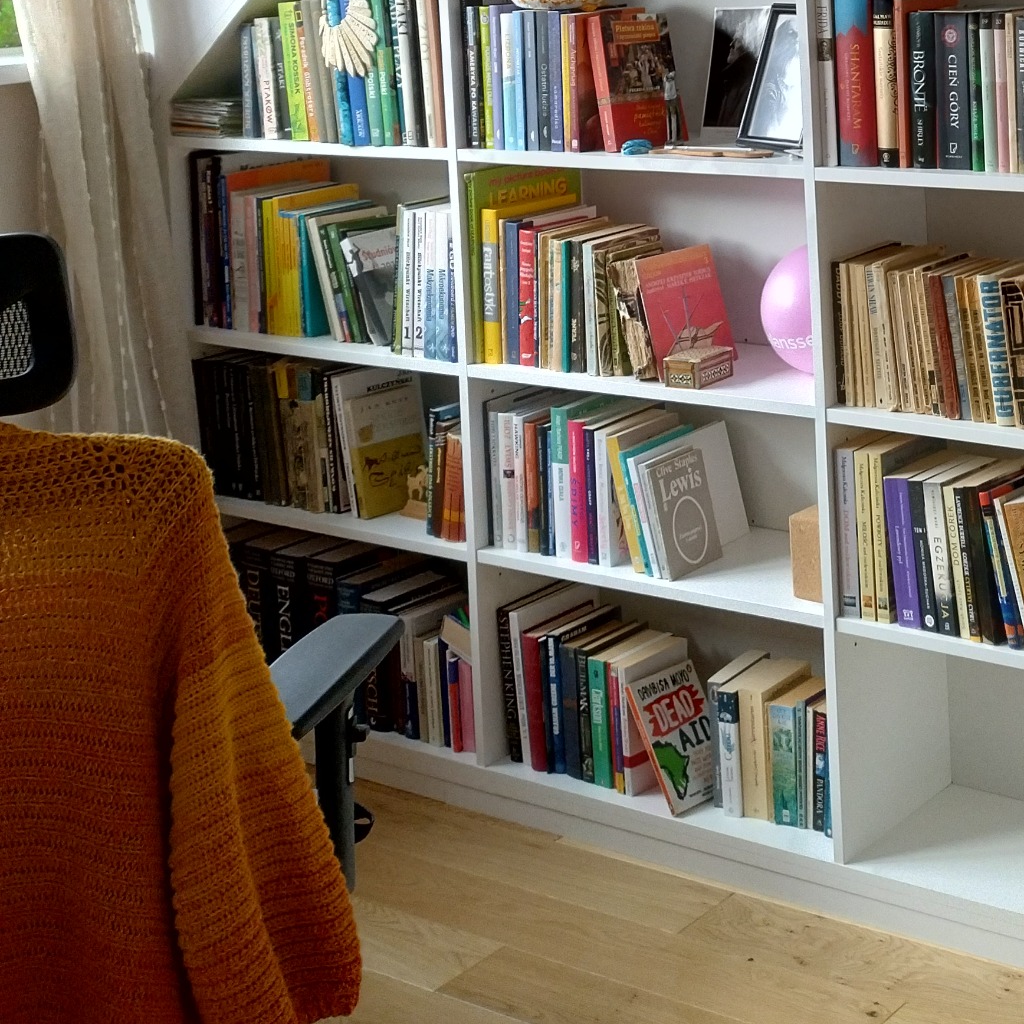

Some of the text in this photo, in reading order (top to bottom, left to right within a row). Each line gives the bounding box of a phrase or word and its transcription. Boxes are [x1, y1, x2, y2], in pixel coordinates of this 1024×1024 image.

[816, 5, 828, 34] FRIDA
[288, 23, 301, 94] SIMONA KOSSAK
[265, 80, 273, 123] PTAKÓW
[850, 43, 862, 129] SHANTARAM
[913, 50, 927, 146] BRONTË SHIRLEY
[948, 54, 959, 129] CIEŃ GÓRY
[489, 177, 567, 206] LEARNING
[416, 327, 423, 339] 2
[980, 280, 1014, 418] GUBERNATOR
[656, 455, 697, 479] Clive Staples
[659, 467, 702, 502] Lewis
[934, 537, 949, 619] EGZEKUCJA
[561, 626, 587, 643] GRAHAM
[499, 616, 517, 720] STEPHEN KING
[592, 689, 603, 724] Clarkson
[637, 678, 670, 701] DAMBISA
[652, 691, 696, 733] DEAD
[679, 715, 711, 752] AID
[815, 714, 826, 752] ANNE RICE
[816, 777, 824, 814] PANDORA
